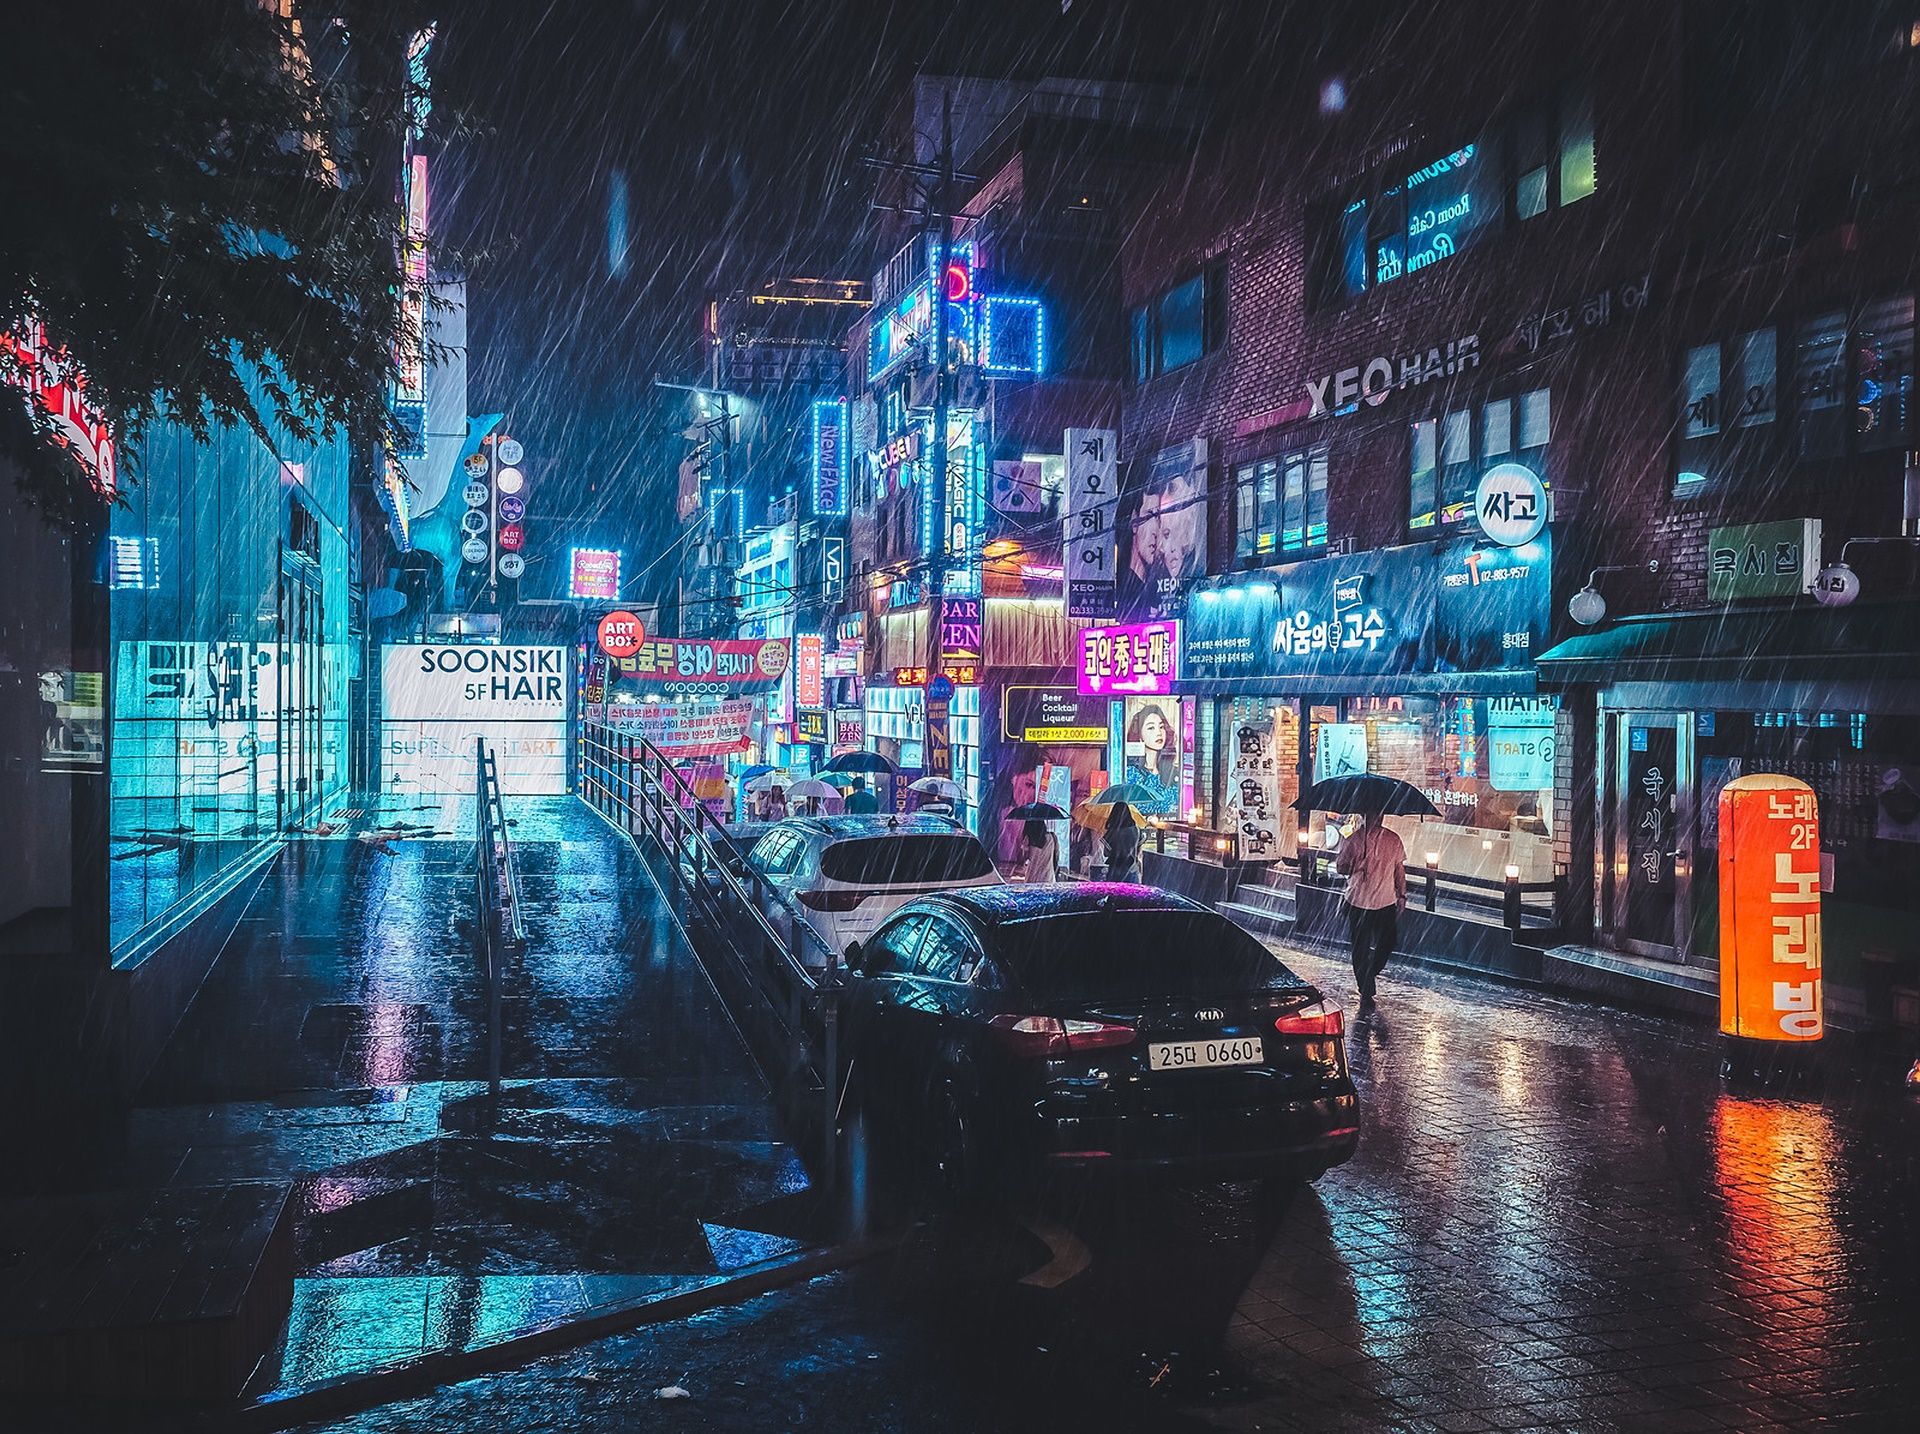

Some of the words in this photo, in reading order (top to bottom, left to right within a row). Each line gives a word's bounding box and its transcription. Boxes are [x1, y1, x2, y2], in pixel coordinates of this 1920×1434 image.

[1305, 356, 1393, 419] XEO
[1399, 333, 1481, 389] HAIR
[1080, 437, 1105, 571] 제오헤어
[1482, 491, 1540, 523] 싸고
[1712, 541, 1800, 579] 국시집
[1072, 584, 1095, 592] XEO
[605, 622, 636, 634] ART
[1272, 610, 1327, 655] 싸움의
[1342, 608, 1386, 652] 고수
[605, 635, 637, 648] BOX
[421, 649, 562, 673] SOONSIKI
[464, 684, 487, 700] 5F
[491, 677, 562, 701] HAIR
[1042, 693, 1063, 702] Beer
[1042, 703, 1078, 712] Cocktail
[1042, 714, 1075, 724] Liqueur
[840, 723, 862, 732] BAR
[840, 732, 862, 741] ZEN
[1641, 766, 1664, 884] 국시집
[1790, 824, 1816, 851] 2F
[1199, 1009, 1222, 1021] KIA
[1206, 1041, 1254, 1064] 0660
